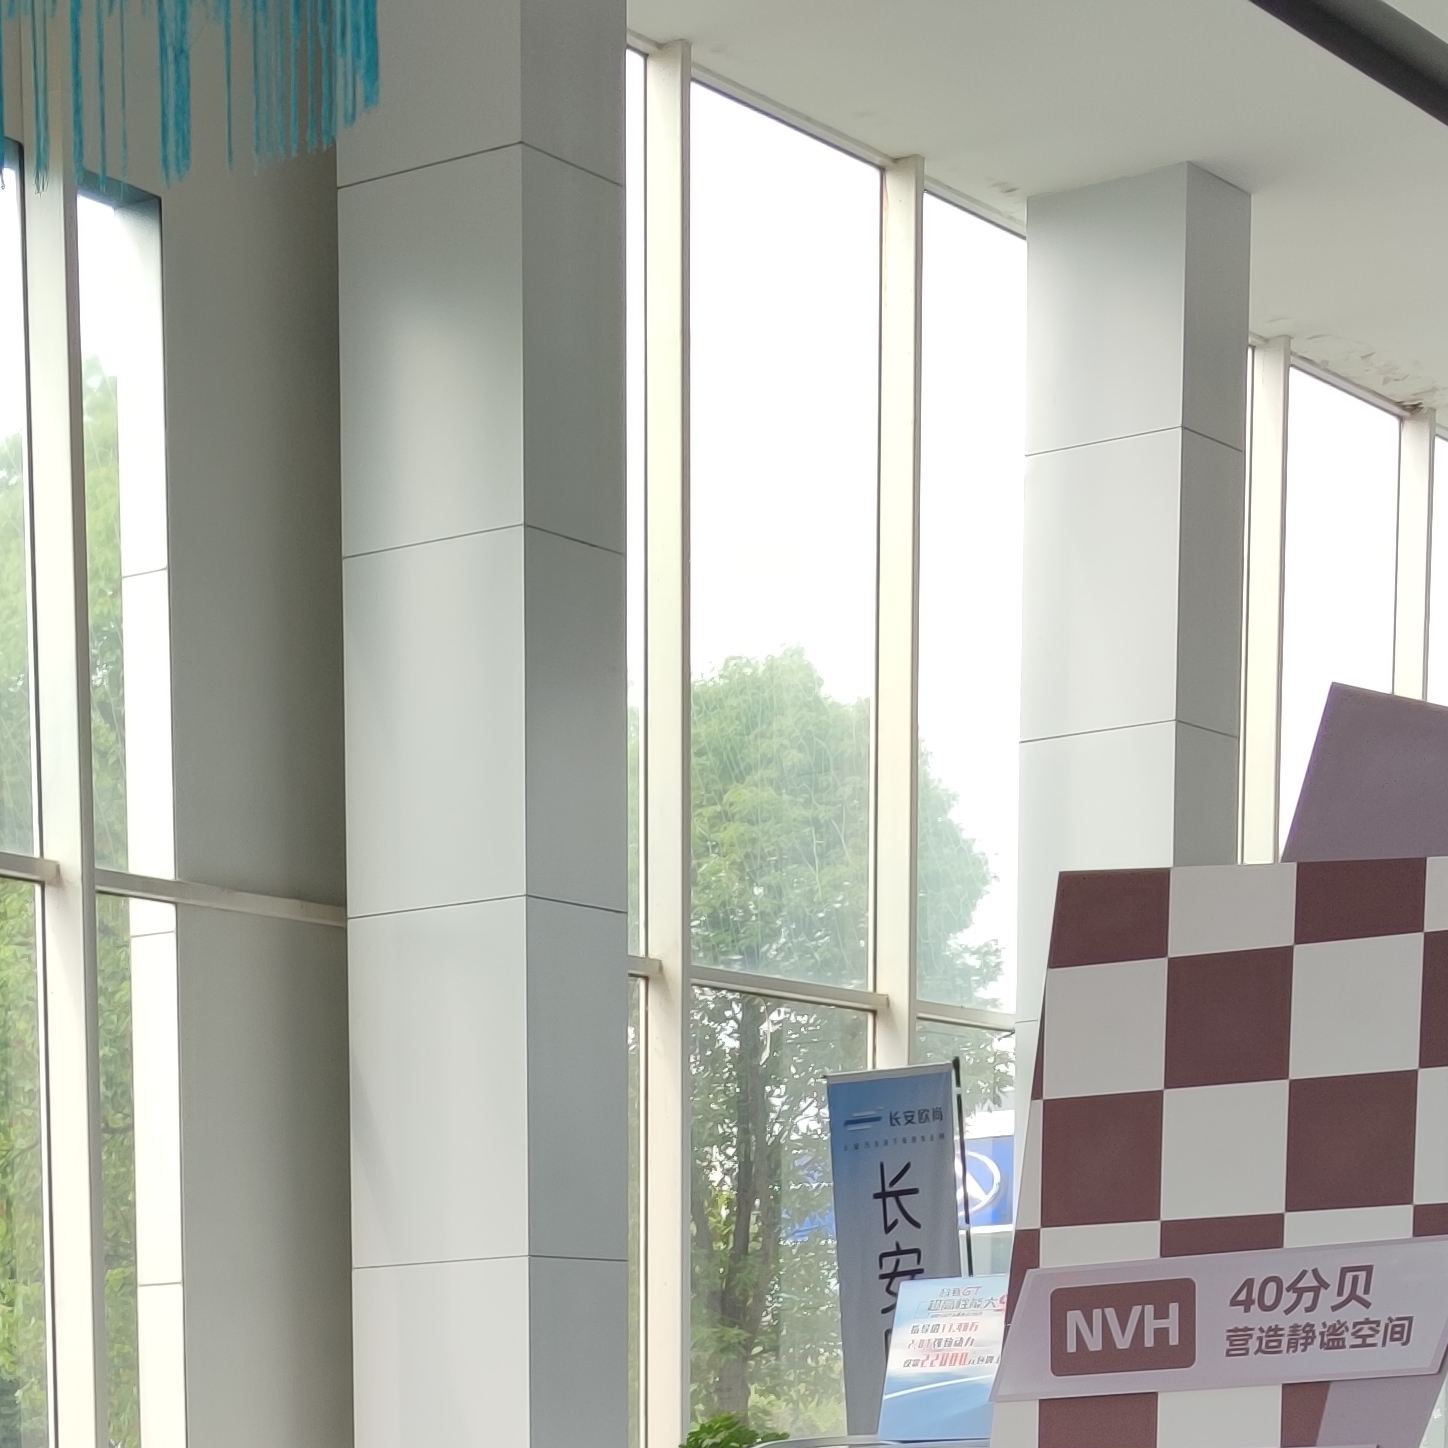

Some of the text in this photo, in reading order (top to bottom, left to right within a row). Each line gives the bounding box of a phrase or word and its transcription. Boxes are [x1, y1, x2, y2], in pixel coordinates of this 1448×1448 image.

[888, 1106, 944, 1127] 长安欧尚
[1228, 1265, 1374, 1314] 40分贝
[1065, 1301, 1181, 1354] NVH
[1223, 1315, 1414, 1358] 营造静谧空间
